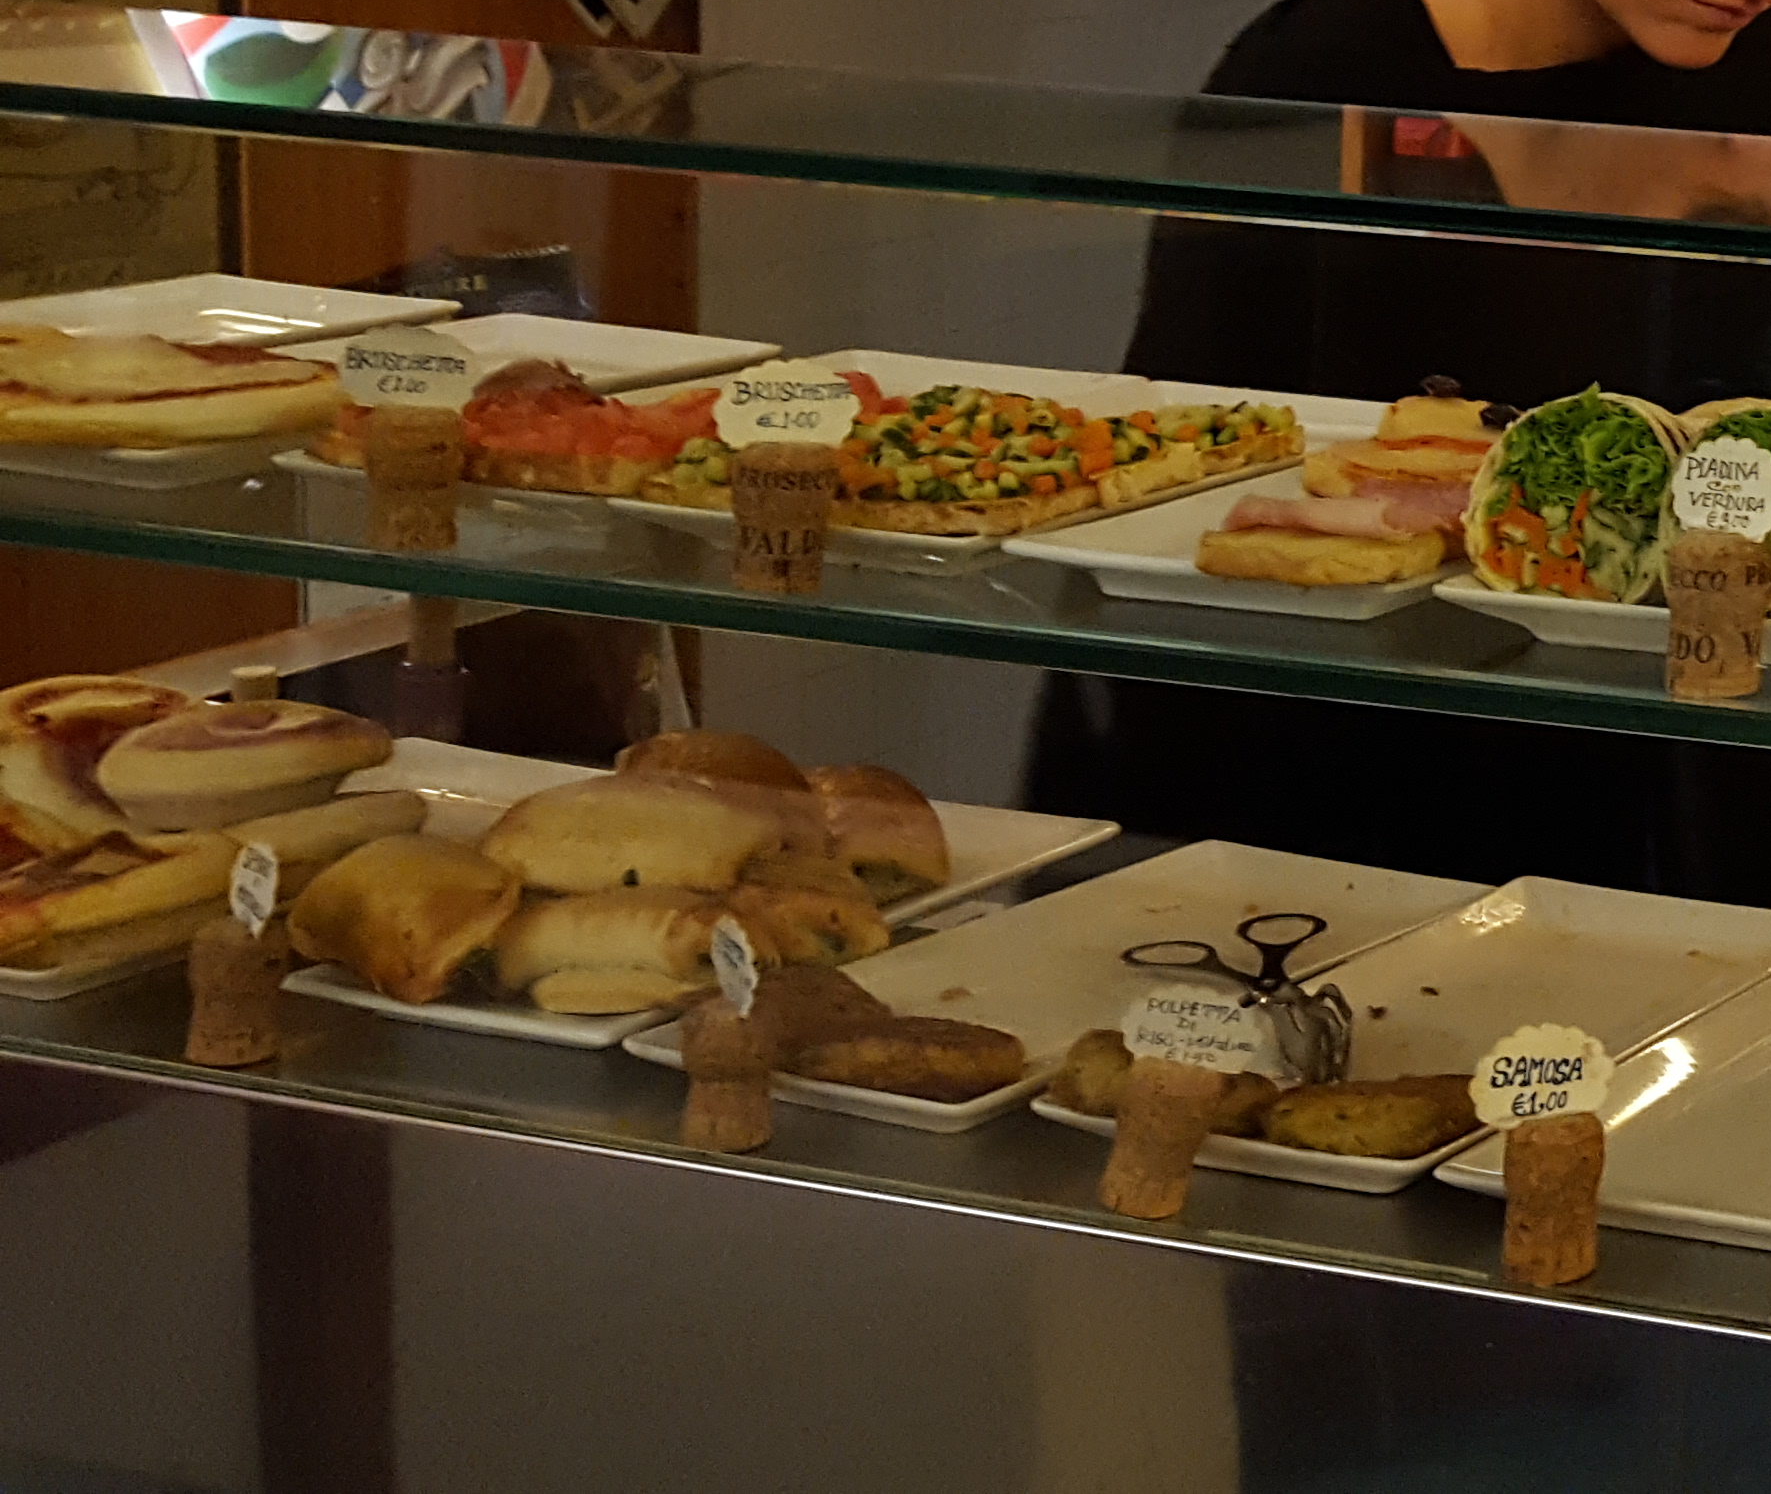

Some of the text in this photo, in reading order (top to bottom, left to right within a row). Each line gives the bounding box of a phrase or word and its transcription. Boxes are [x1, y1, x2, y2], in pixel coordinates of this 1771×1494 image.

[1685, 456, 1760, 481] PIADINA
[1688, 490, 1765, 513] VERDURA
[1491, 1055, 1583, 1088] SAMOSA
